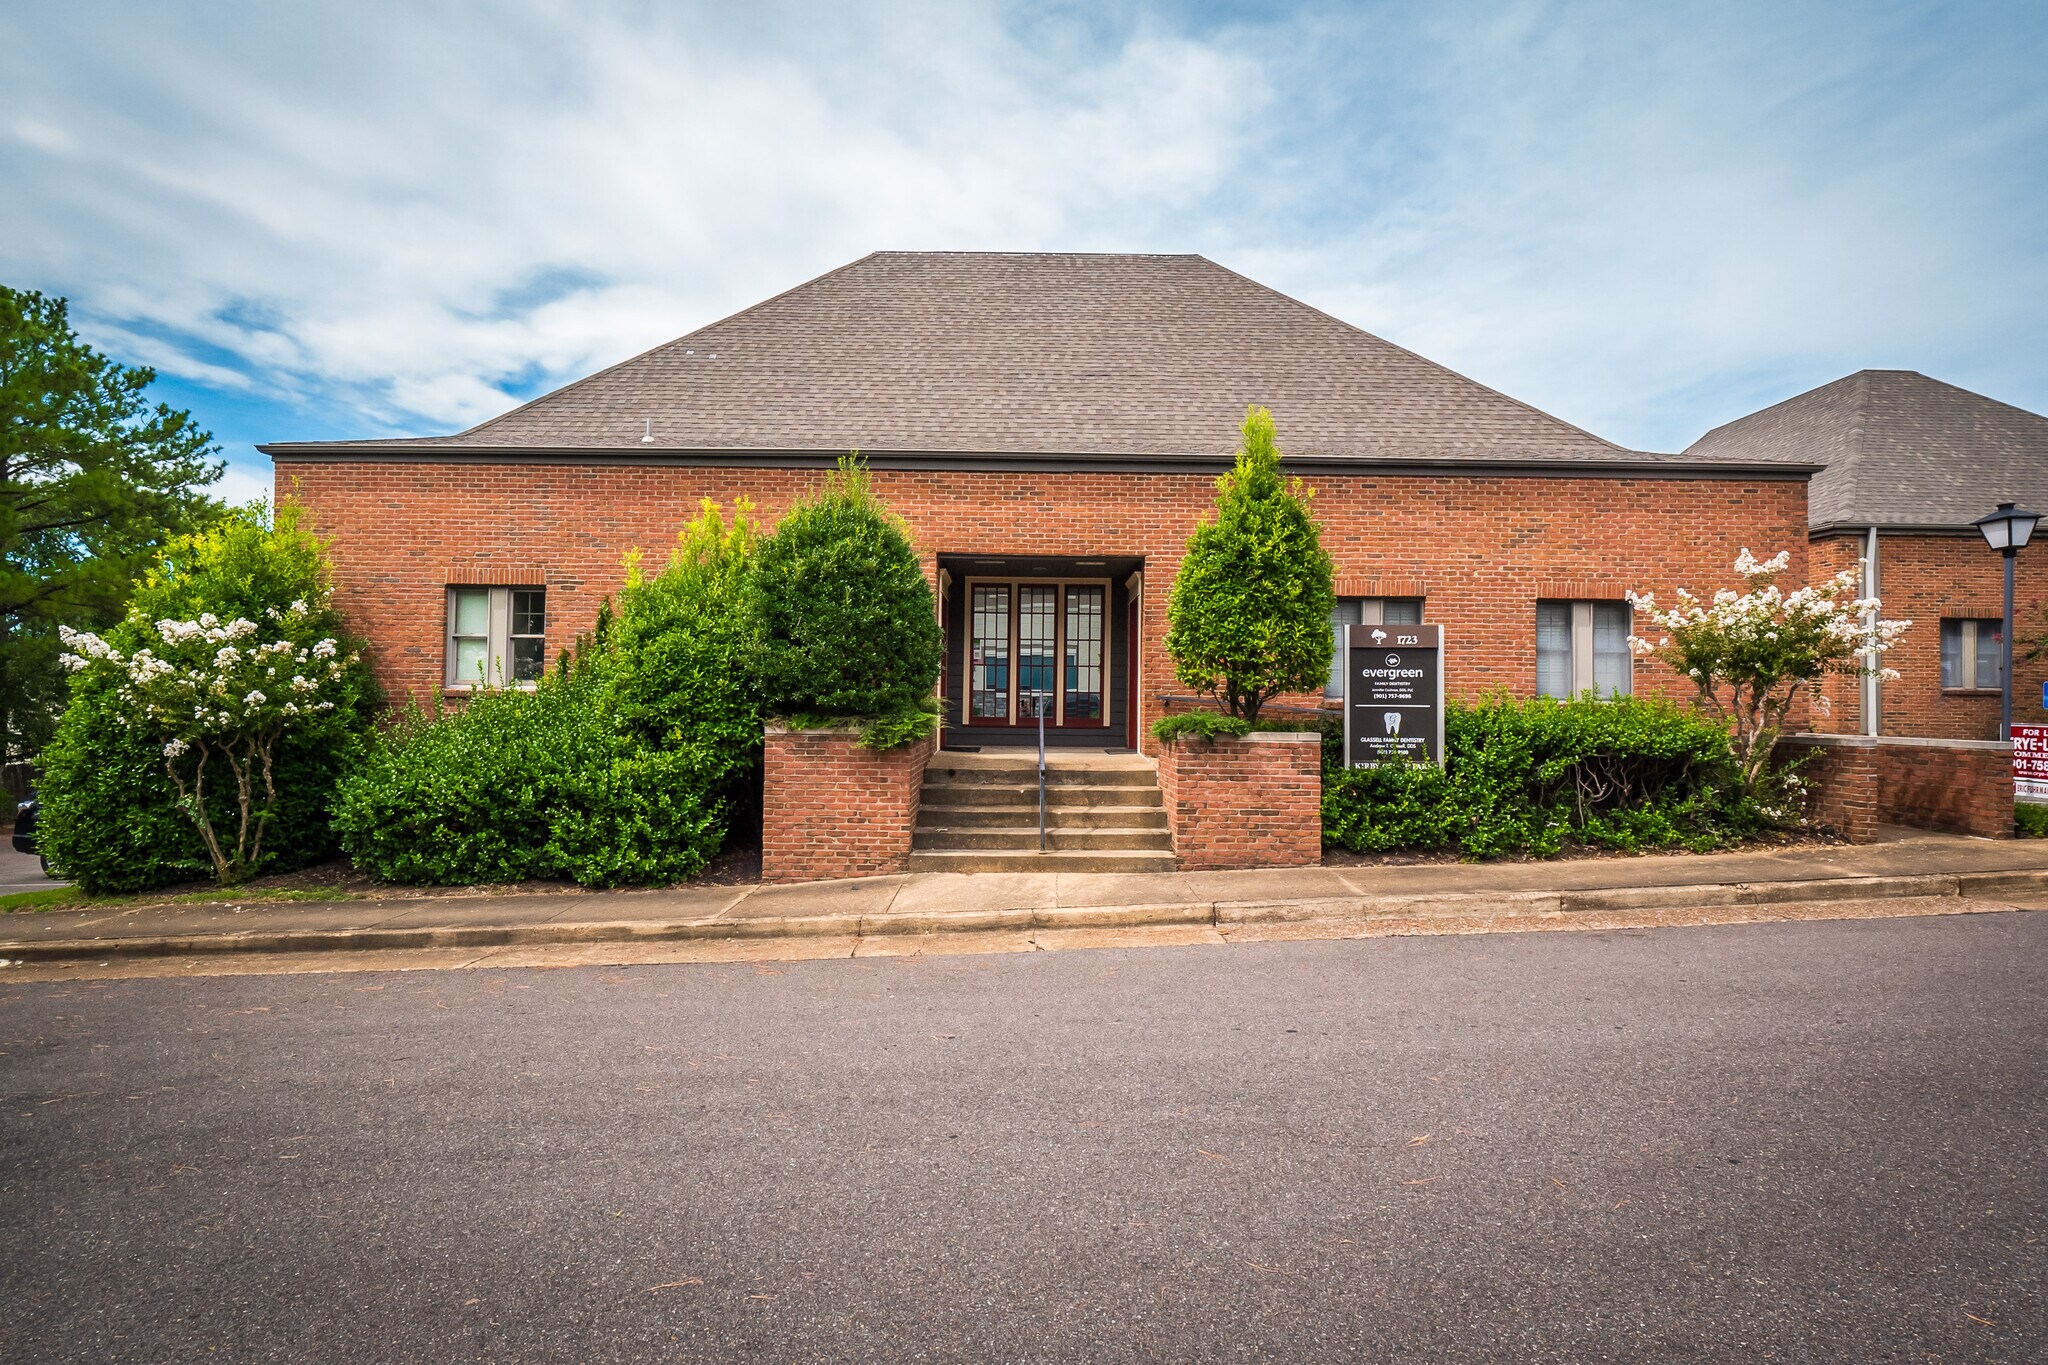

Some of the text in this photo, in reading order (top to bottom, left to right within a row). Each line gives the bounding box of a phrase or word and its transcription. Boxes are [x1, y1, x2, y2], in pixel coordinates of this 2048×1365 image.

[1397, 635, 1418, 645] 1723
[1362, 669, 1423, 680] evergreen
[2022, 728, 2040, 737] FOR
[2010, 737, 2048, 751] RYE-L
[2012, 750, 2048, 759] OMME
[2027, 785, 2048, 794] FUHRMA
